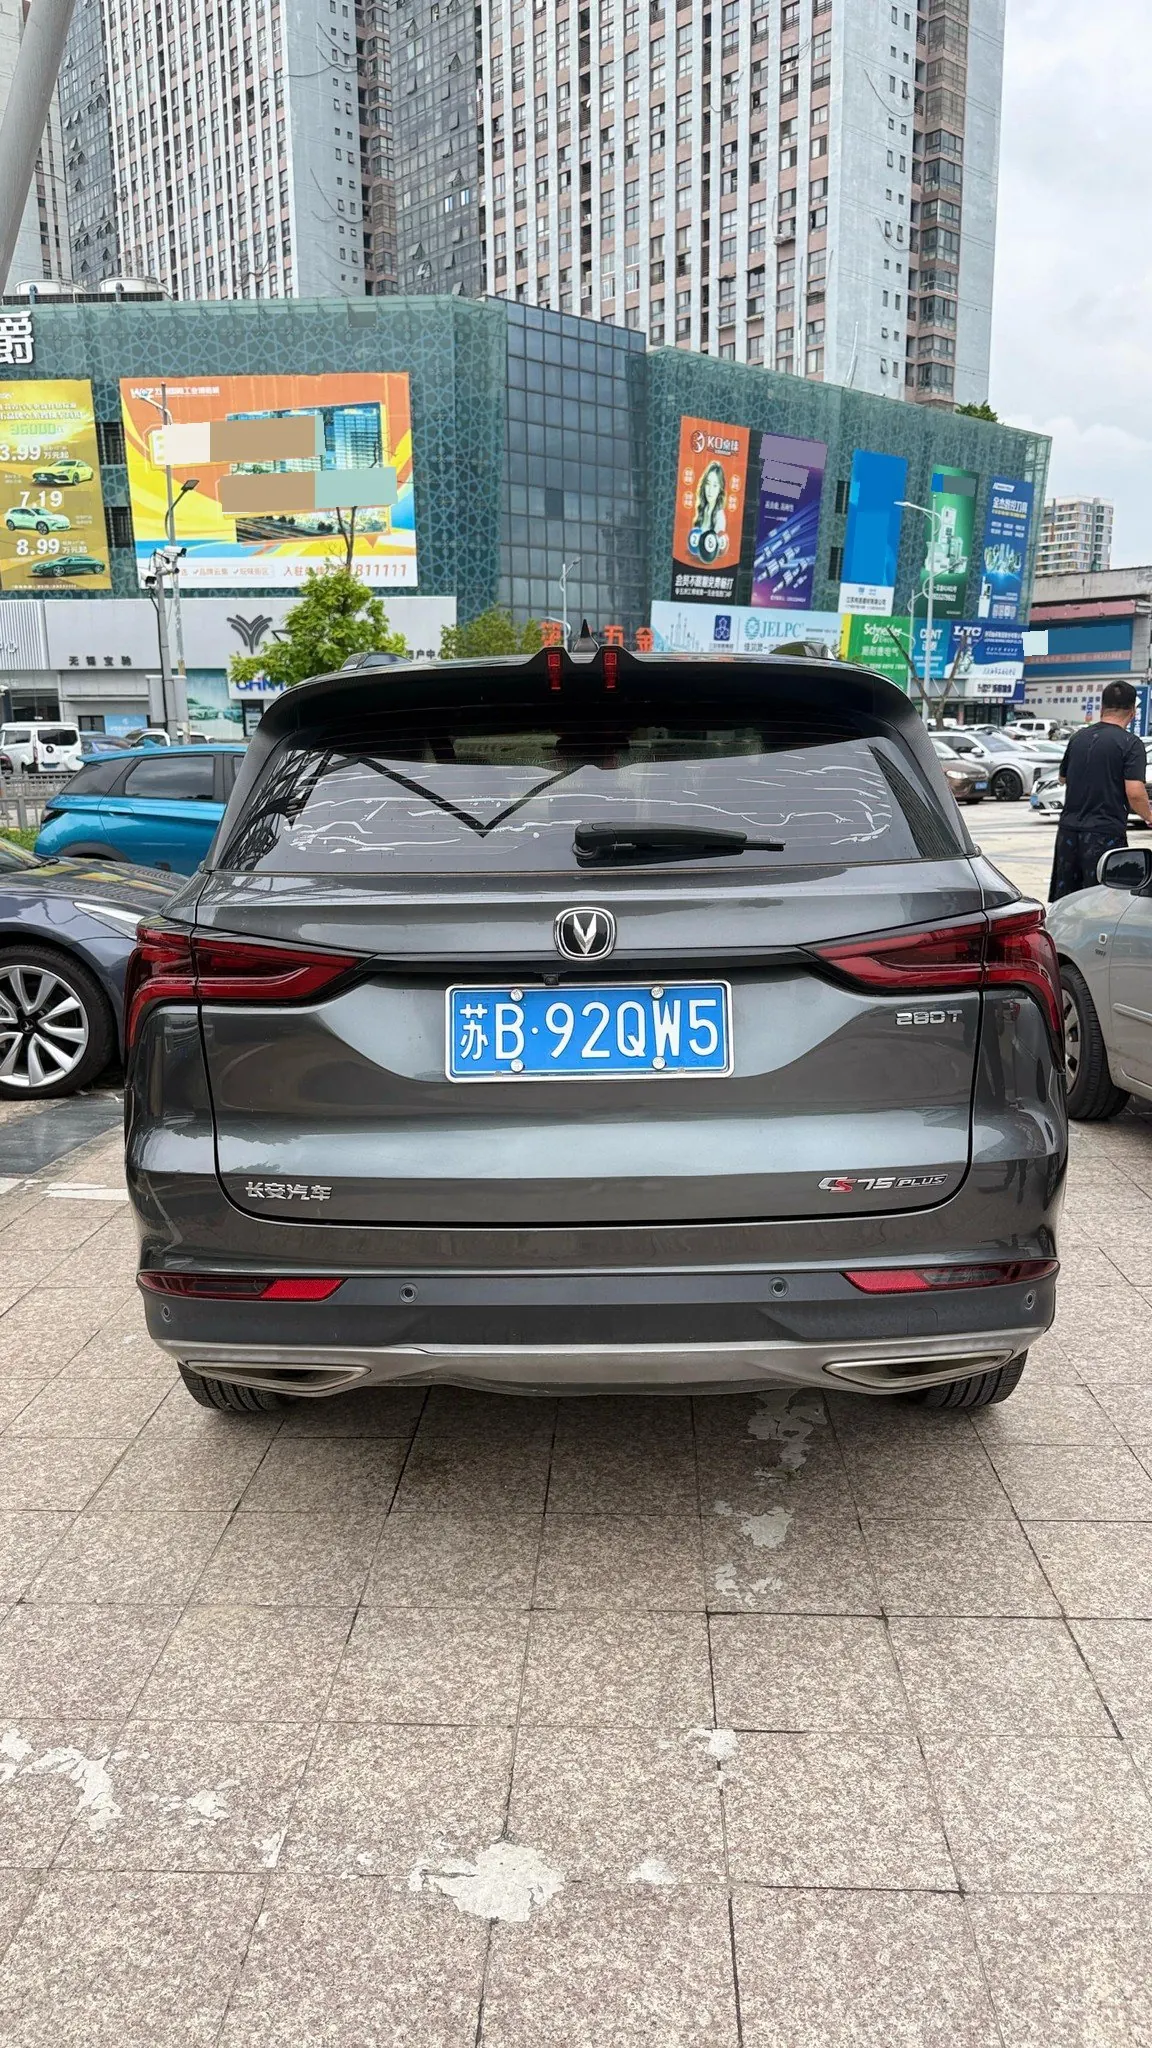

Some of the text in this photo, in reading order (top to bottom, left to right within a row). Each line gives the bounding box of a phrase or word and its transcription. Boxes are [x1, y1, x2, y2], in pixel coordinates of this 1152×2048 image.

[20, 490, 62, 507] 7.19
[16, 538, 60, 555] 8.99
[760, 619, 802, 640] JELPC
[896, 1010, 962, 1025] 280T
[459, 999, 718, 1060] 苏B·92QW5
[899, 1175, 946, 1187] PLUS
[245, 1182, 332, 1201] 长安汽车
